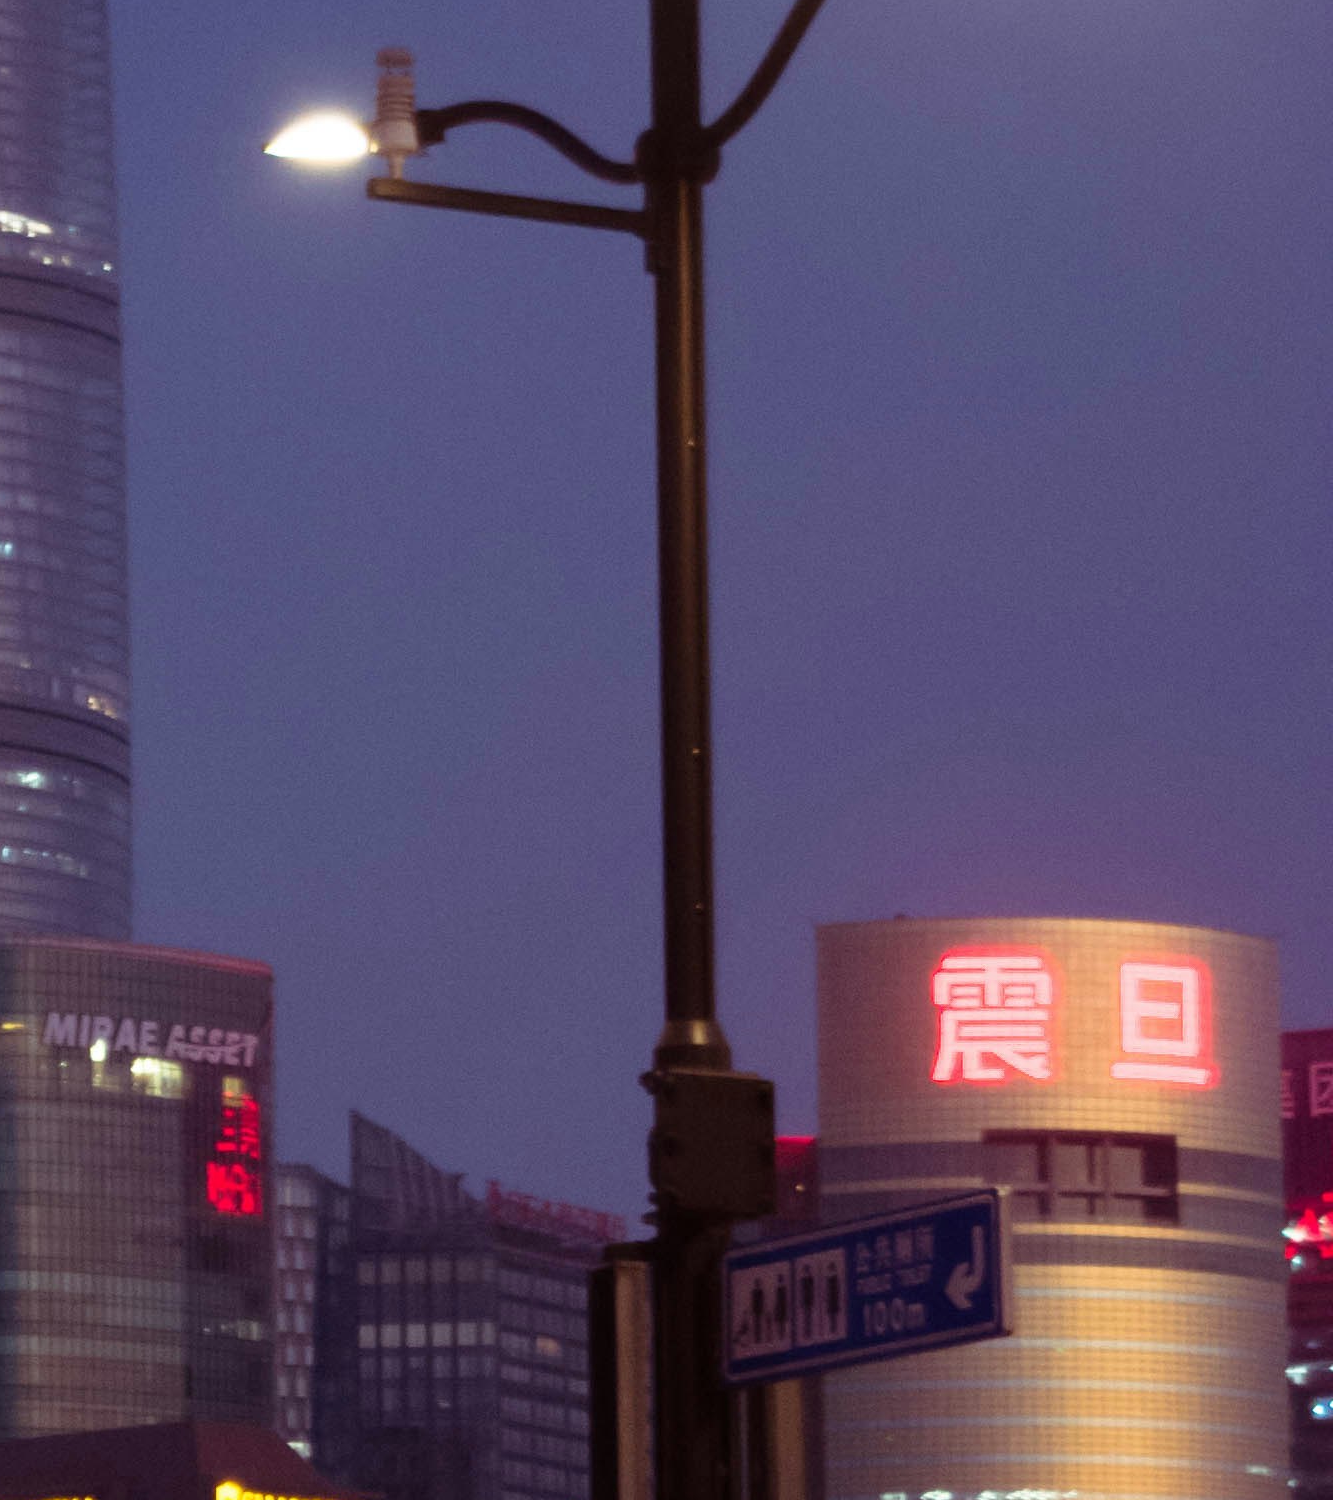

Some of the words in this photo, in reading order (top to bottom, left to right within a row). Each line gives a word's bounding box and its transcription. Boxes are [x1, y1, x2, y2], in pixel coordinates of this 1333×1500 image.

[42, 1011, 160, 1057] MIRAE
[164, 1023, 259, 1068] ASSET
[932, 955, 1212, 1085] 震旦
[863, 1297, 927, 1337] 100m
